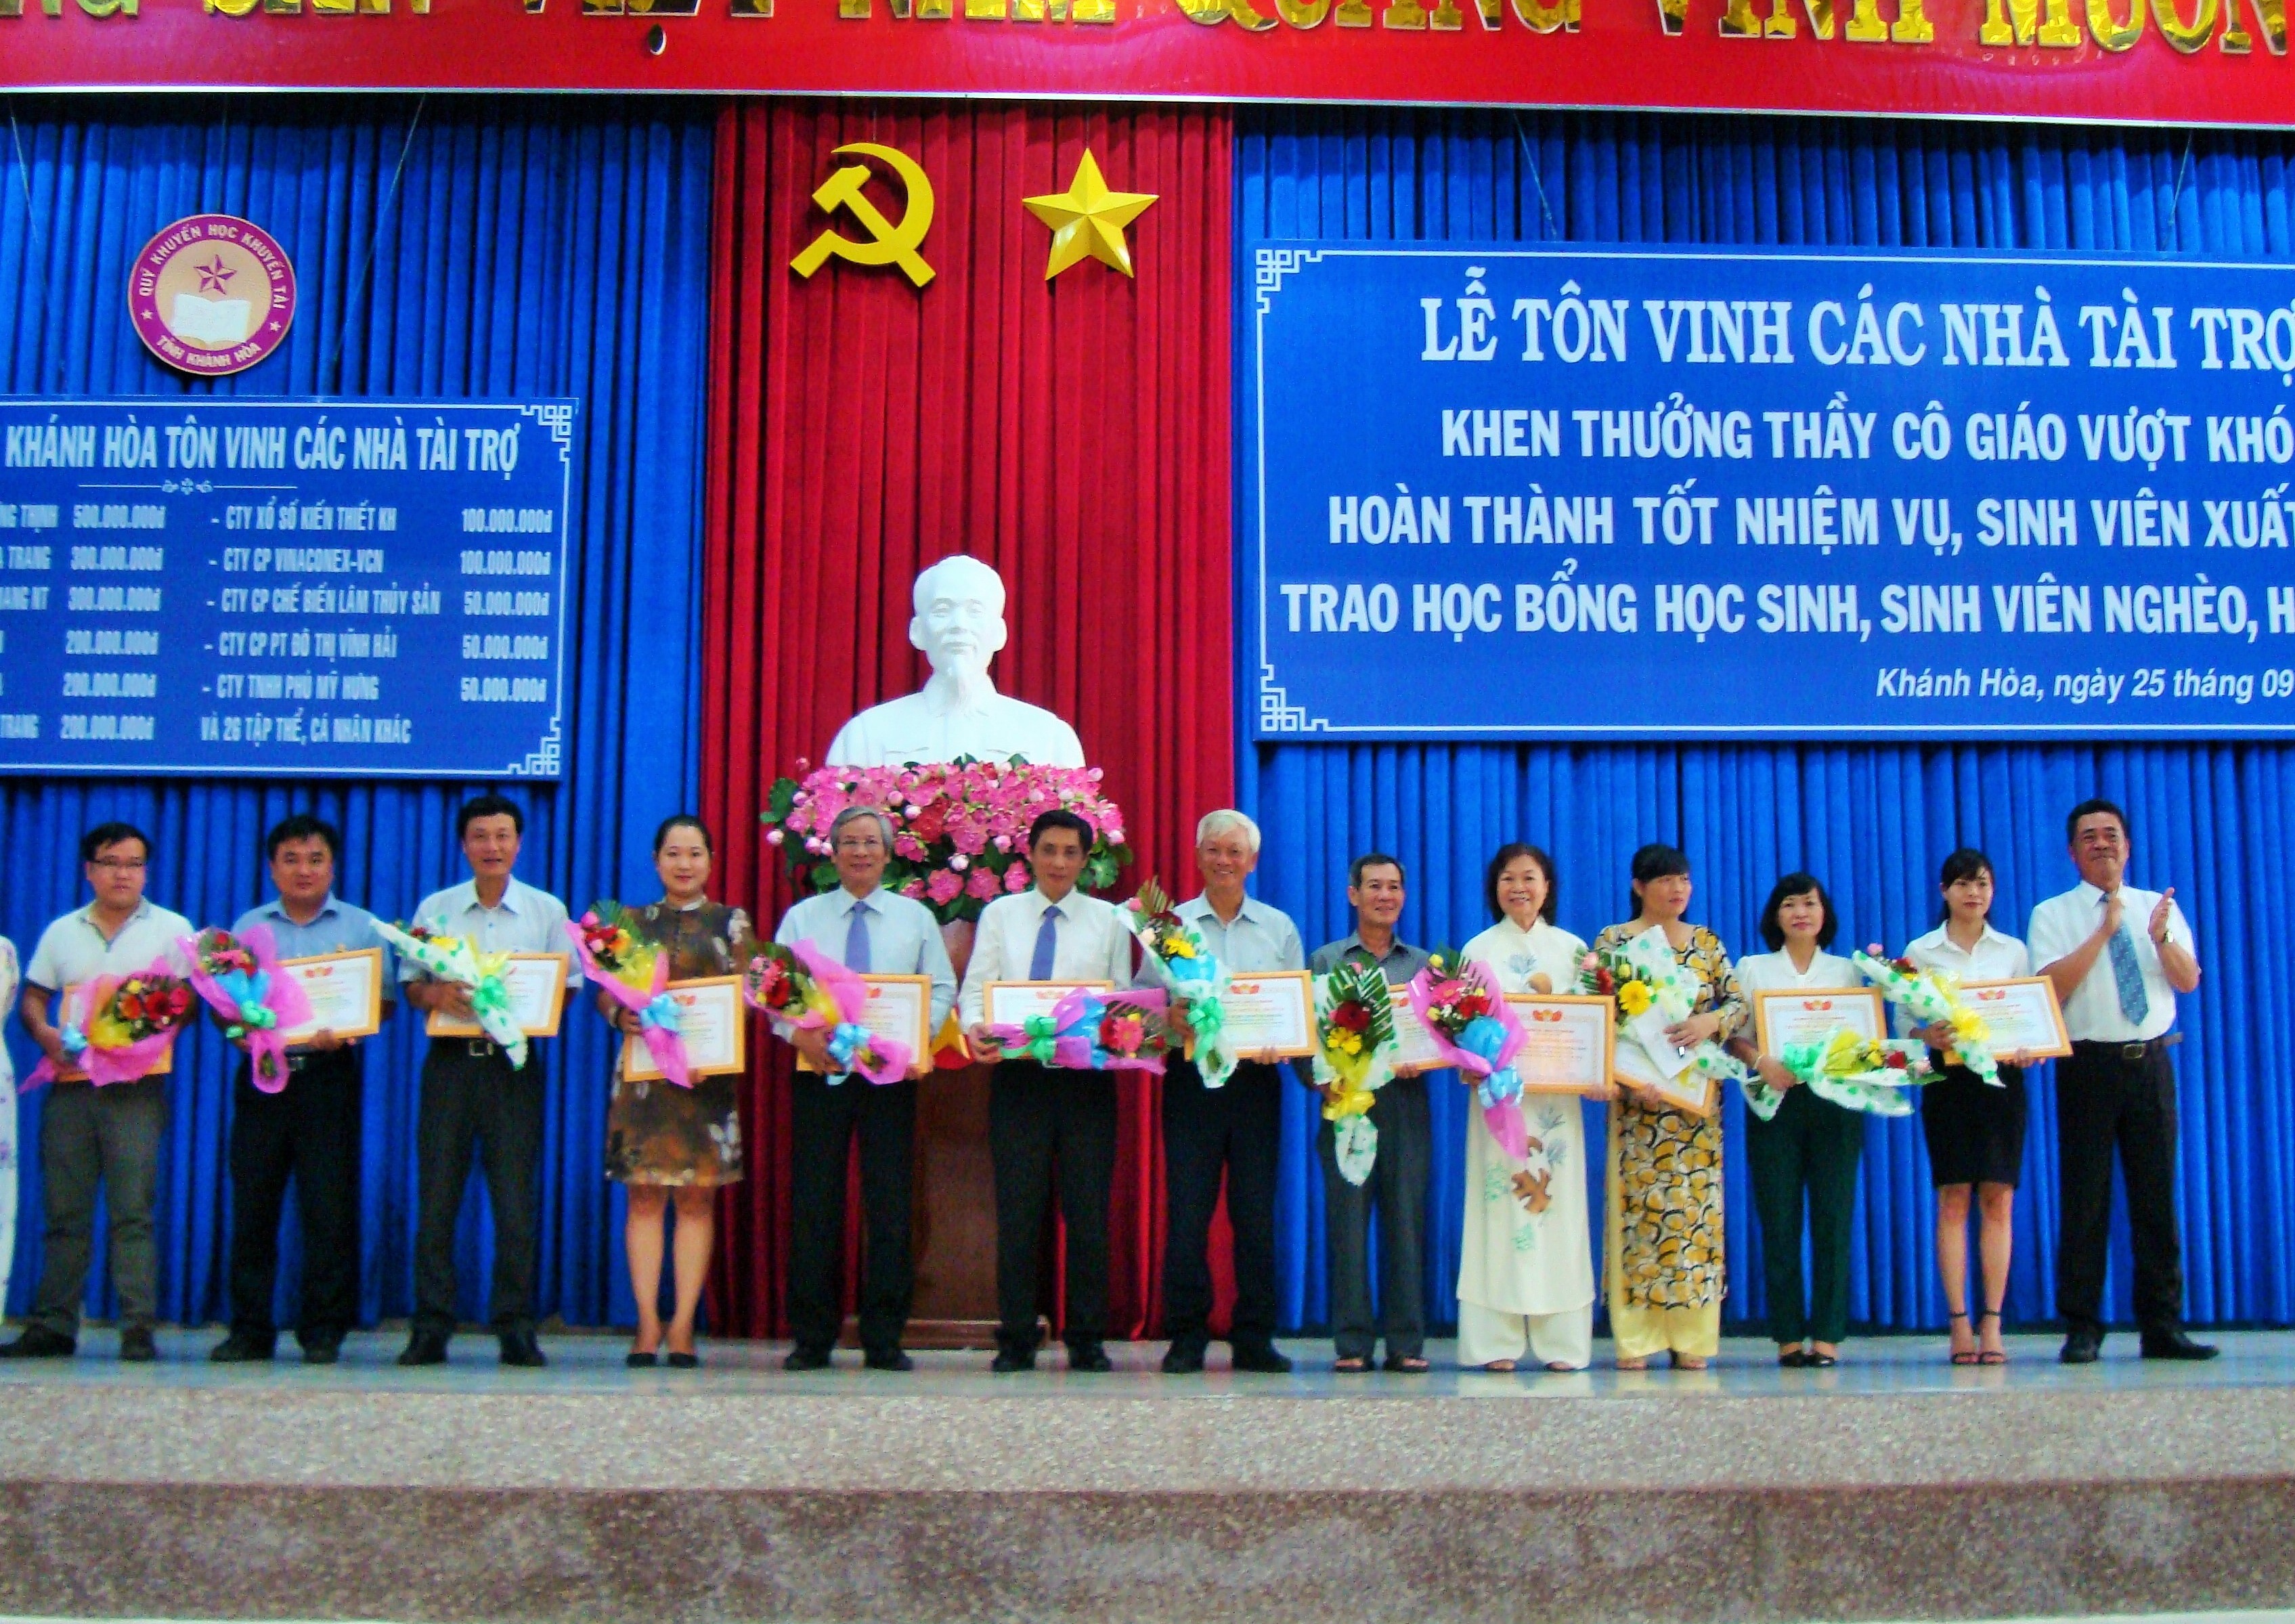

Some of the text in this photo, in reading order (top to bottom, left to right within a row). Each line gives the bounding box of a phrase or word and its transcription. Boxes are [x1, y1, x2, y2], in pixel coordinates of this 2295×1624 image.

[208, 224, 239, 239] HỌC
[1421, 267, 2295, 387] LỄ TÔN VINH CÁC NHÀ TÀI TRỢ
[5, 414, 521, 481] KHÁNH HÒA TÔN VINH CÁC NHÀ TÀI TRỢ
[1442, 391, 2294, 472] KHEN THƯỞNG THẦY CÔ GIÁO VƯỢT KHÓ
[225, 505, 252, 529] CTY
[278, 499, 299, 530] SỐ
[301, 499, 334, 530] KIẾN
[336, 500, 376, 531] THIẾT
[378, 508, 397, 531] KH
[462, 508, 553, 533] 100.000.000đ
[1329, 483, 1451, 545] HOÀN
[1463, 483, 1613, 544] THÀNH
[1633, 478, 1719, 546] TỐT
[1736, 485, 1879, 555] NHIỆM
[1893, 498, 1963, 556] VỤ,
[1977, 498, 2078, 547] SINH
[2091, 487, 2190, 547] VIÊN
[8, 546, 51, 570] TRANG
[223, 548, 250, 571] CTY
[253, 548, 271, 572] CP
[460, 550, 551, 575] 100.000.000đ
[221, 588, 248, 613] CTY
[250, 588, 269, 613] CP
[272, 581, 301, 613] CHẾ
[303, 581, 336, 613] BIẾN
[338, 584, 370, 613] LÂM
[464, 591, 550, 615] 50.000.000đ
[1280, 584, 1399, 633] TRAO
[1412, 583, 1502, 642] HỌC
[1515, 558, 1637, 633] BỔNG
[1655, 584, 1745, 642] HỌC
[1757, 584, 1872, 642] SINH,
[1880, 584, 1982, 633] SINH
[1992, 572, 2092, 633] VIÊN
[2104, 573, 2259, 643] NGHÈO,
[219, 632, 246, 656] CTY
[248, 632, 267, 657] CP
[269, 632, 287, 657] PT
[462, 634, 548, 660] 50.000.000đ
[217, 674, 244, 699] CTY
[460, 677, 547, 701] 50.000.000đ
[1876, 667, 2295, 704] Khánh Hòa, ngày 25 tháng 09
[244, 712, 272, 747] TẬP
[311, 712, 329, 742] CÁ
[333, 714, 372, 743] NHÂN
[374, 714, 412, 744] KHÁC
